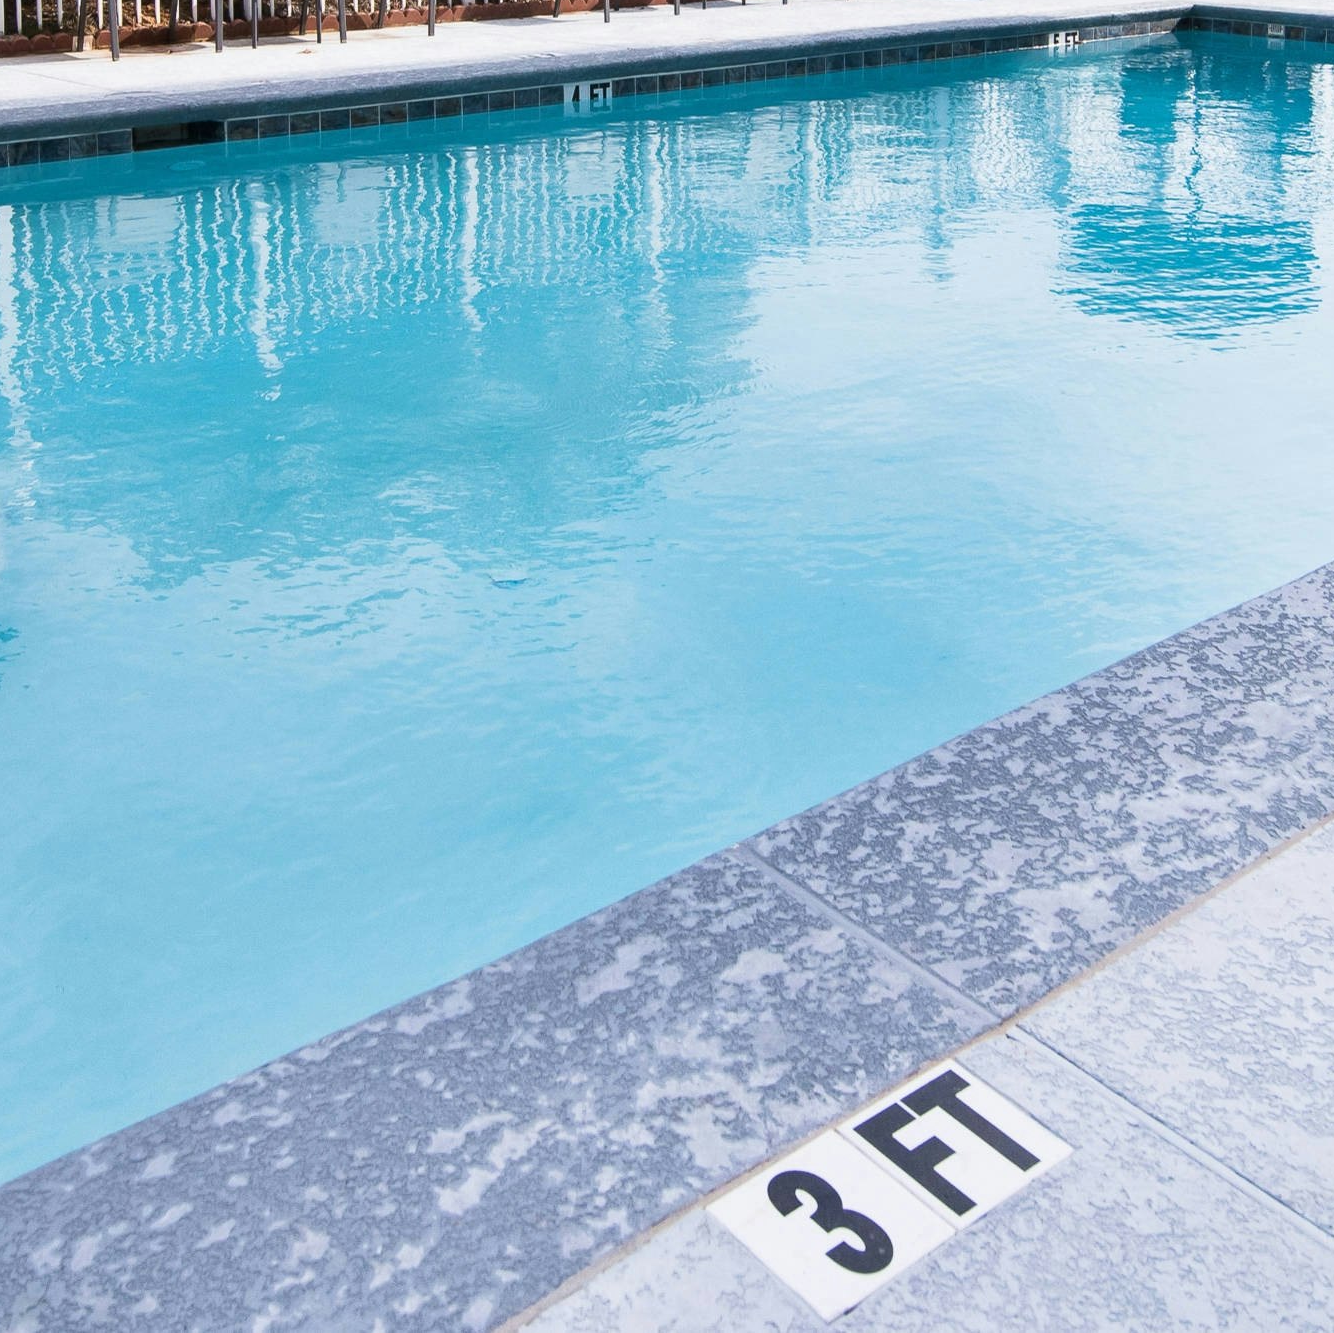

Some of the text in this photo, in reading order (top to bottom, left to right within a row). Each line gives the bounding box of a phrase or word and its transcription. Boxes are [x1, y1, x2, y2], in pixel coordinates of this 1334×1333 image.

[589, 82, 611, 101] FT
[767, 1069, 1041, 1275] 3 FT
